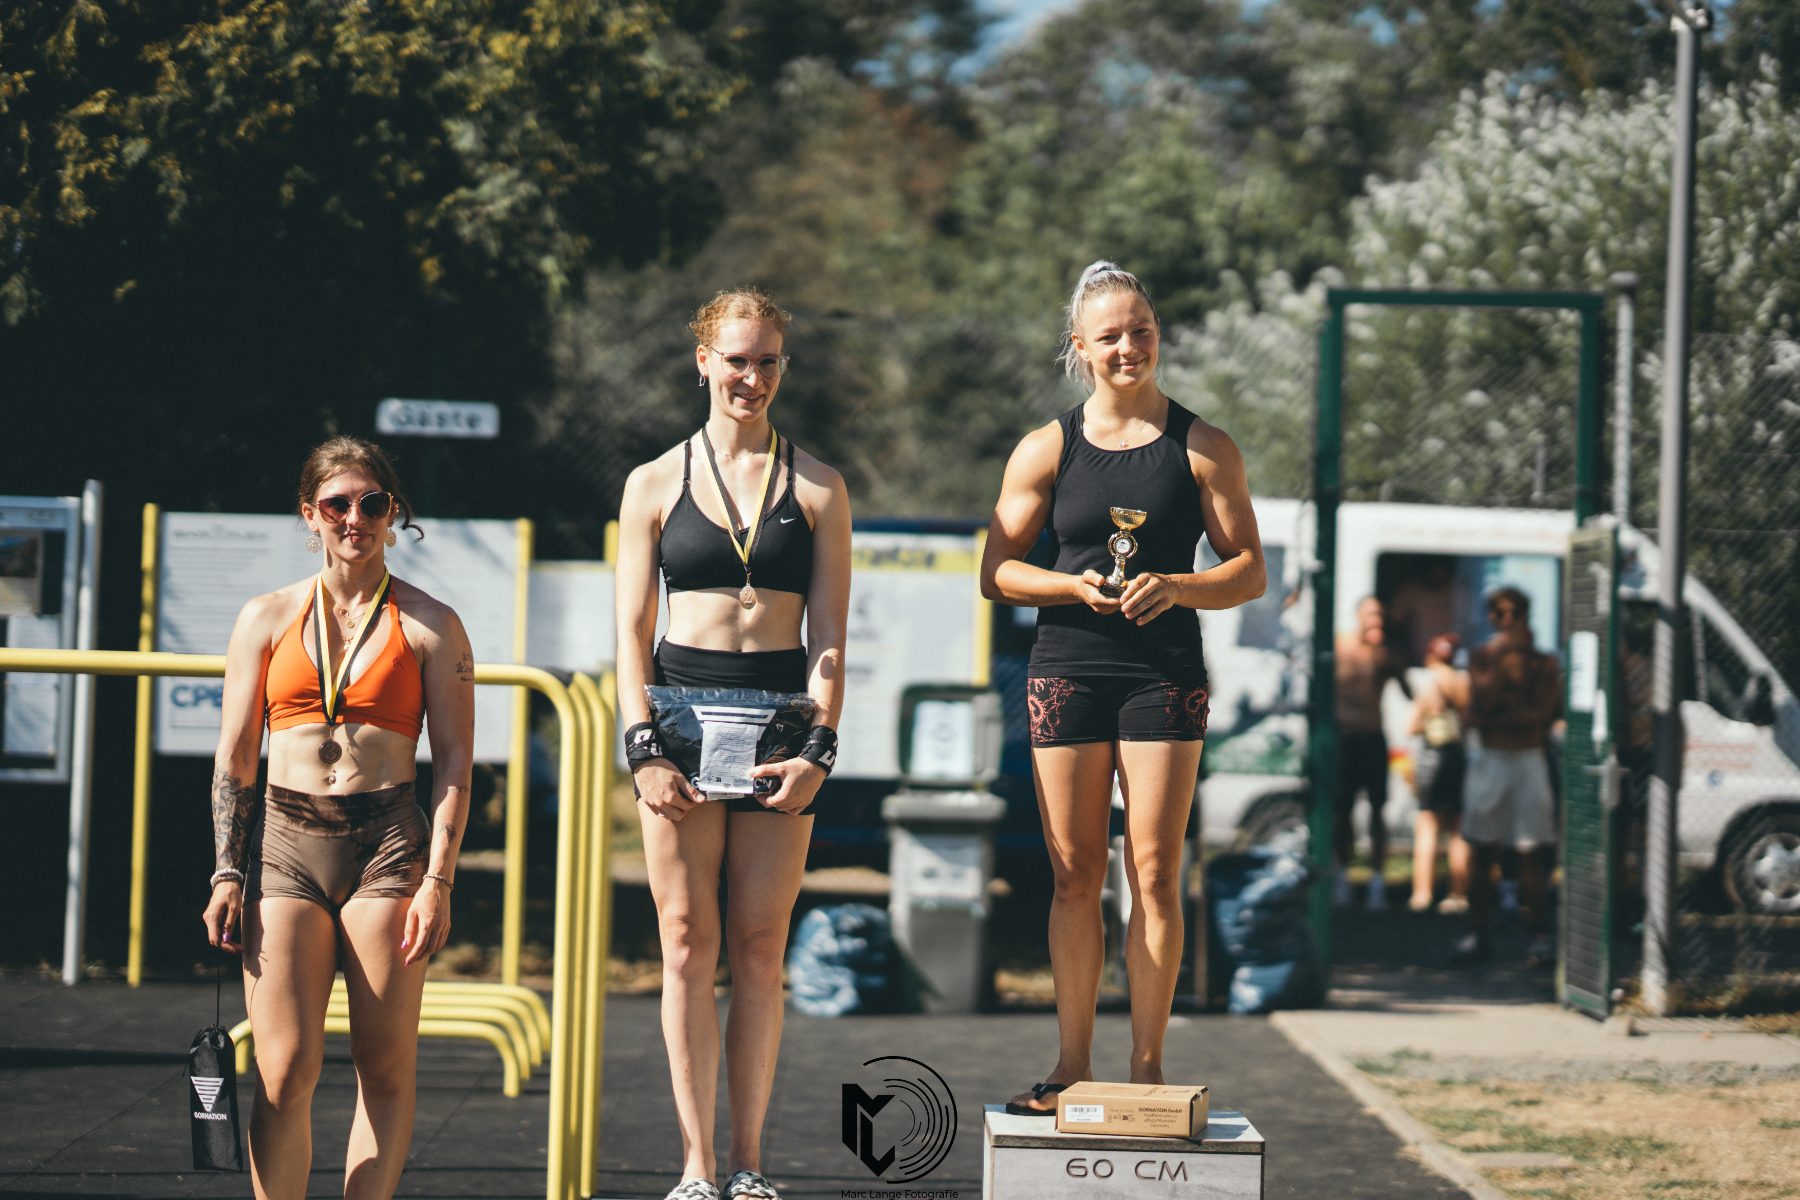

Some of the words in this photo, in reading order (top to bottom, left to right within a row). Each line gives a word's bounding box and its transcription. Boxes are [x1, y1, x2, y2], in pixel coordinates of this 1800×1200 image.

[193, 1111, 227, 1120] GORNATION
[1066, 1158, 1114, 1179] 60
[1135, 1160, 1188, 1182] CM
